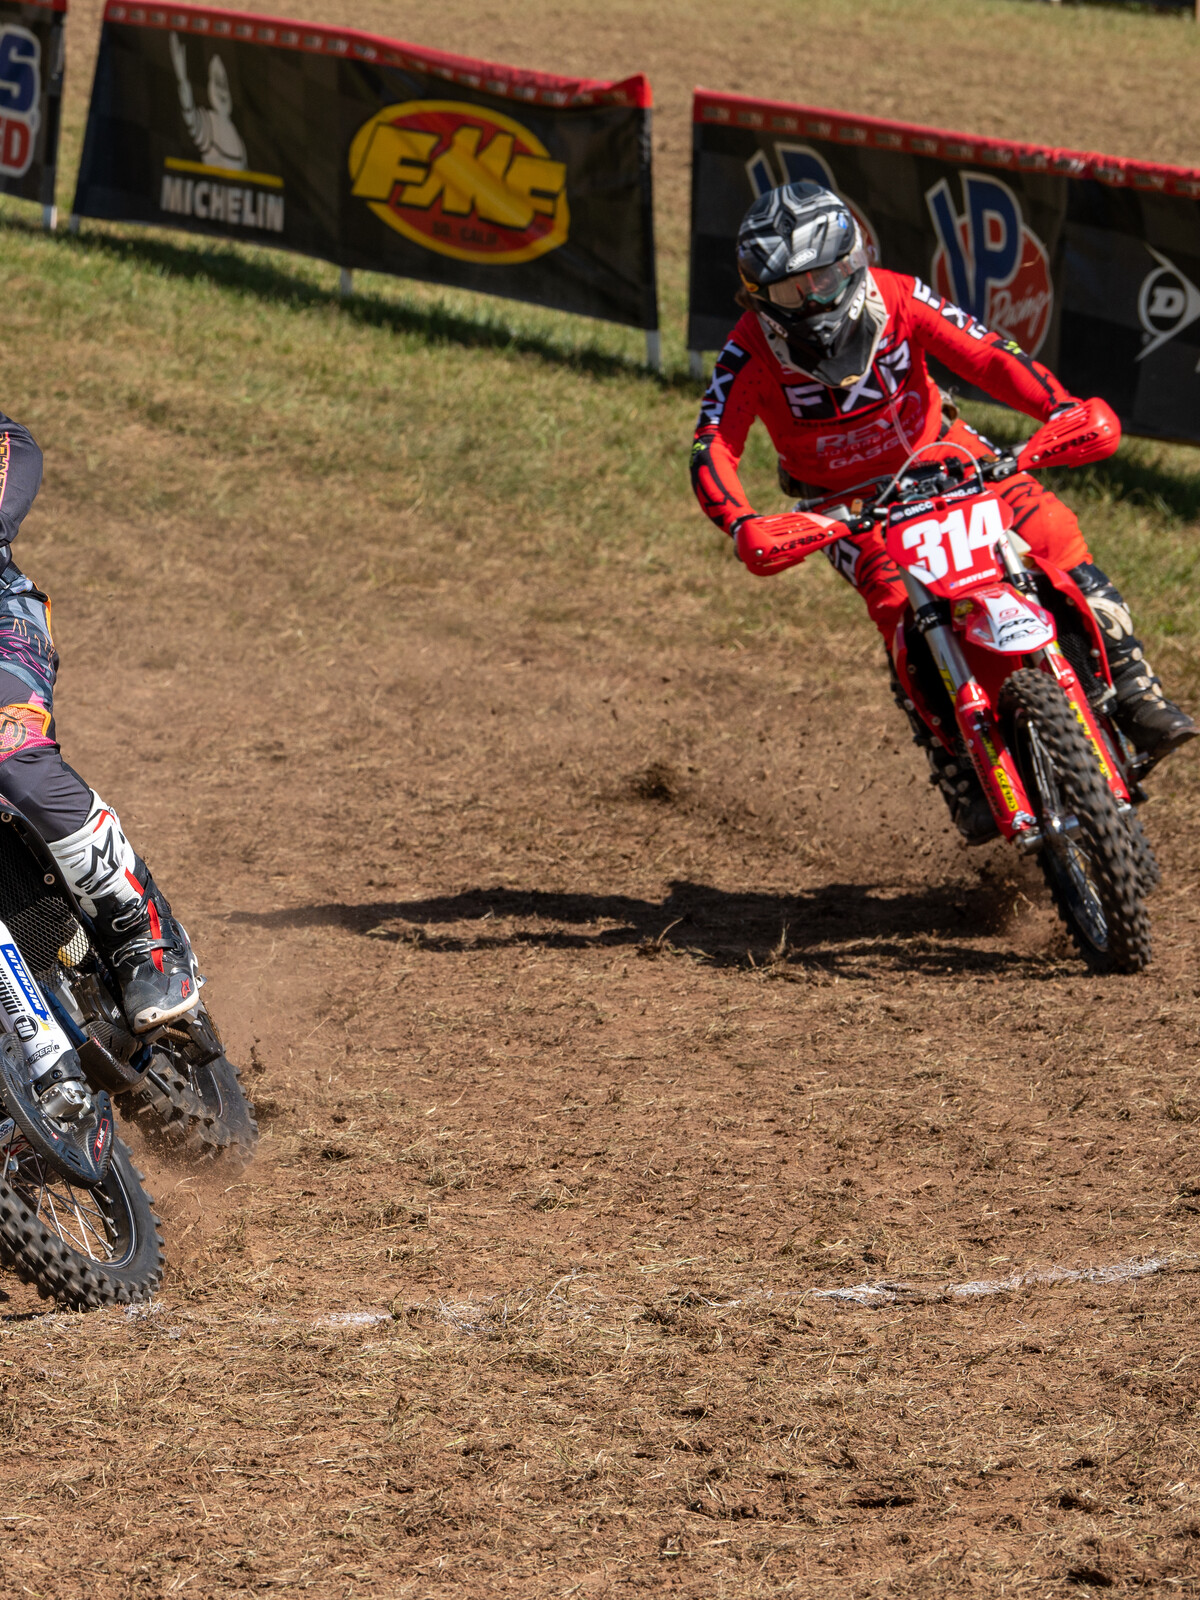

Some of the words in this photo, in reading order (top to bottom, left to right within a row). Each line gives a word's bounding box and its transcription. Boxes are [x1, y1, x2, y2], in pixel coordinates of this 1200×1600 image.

[160, 175, 285, 232] MICHELIN
[785, 339, 911, 418] FXR
[902, 499, 1004, 585] 314
[4, 948, 44, 1012] MICHELIN
